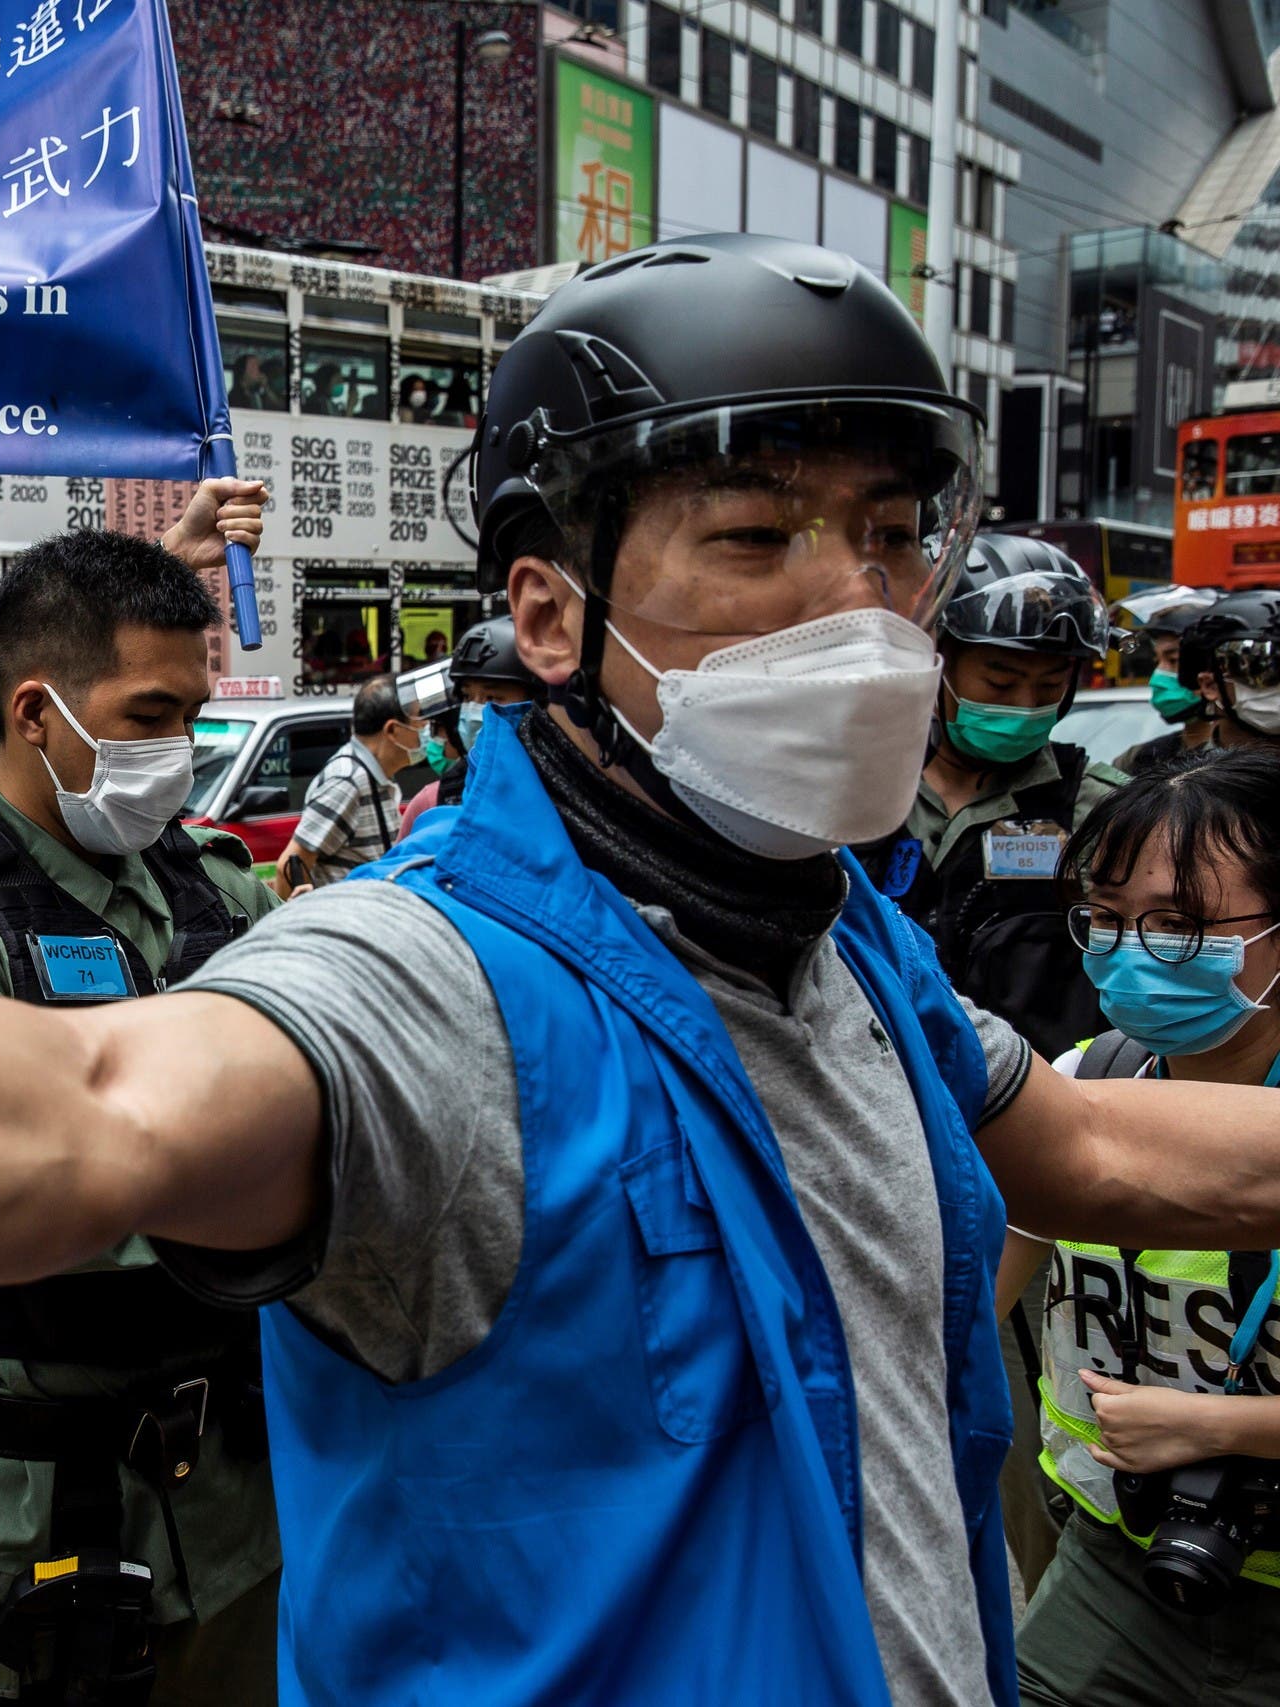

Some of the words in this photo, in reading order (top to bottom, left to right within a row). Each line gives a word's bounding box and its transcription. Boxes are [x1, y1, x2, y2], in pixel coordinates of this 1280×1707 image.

[23, 276, 69, 316] in
[291, 435, 337, 460] SIGG
[390, 444, 431, 467] SIGG
[291, 461, 342, 484] PRIZE
[390, 467, 435, 490] PRIZE
[10, 484, 48, 503] 2020
[291, 485, 342, 515] 希克獎
[67, 506, 106, 530] 201
[347, 501, 376, 518] 2020
[291, 516, 333, 539] 2019
[390, 520, 428, 542] 2019
[220, 680, 270, 696] TAXI
[44, 943, 114, 961] WCHDIST
[77, 969, 96, 985] 71
